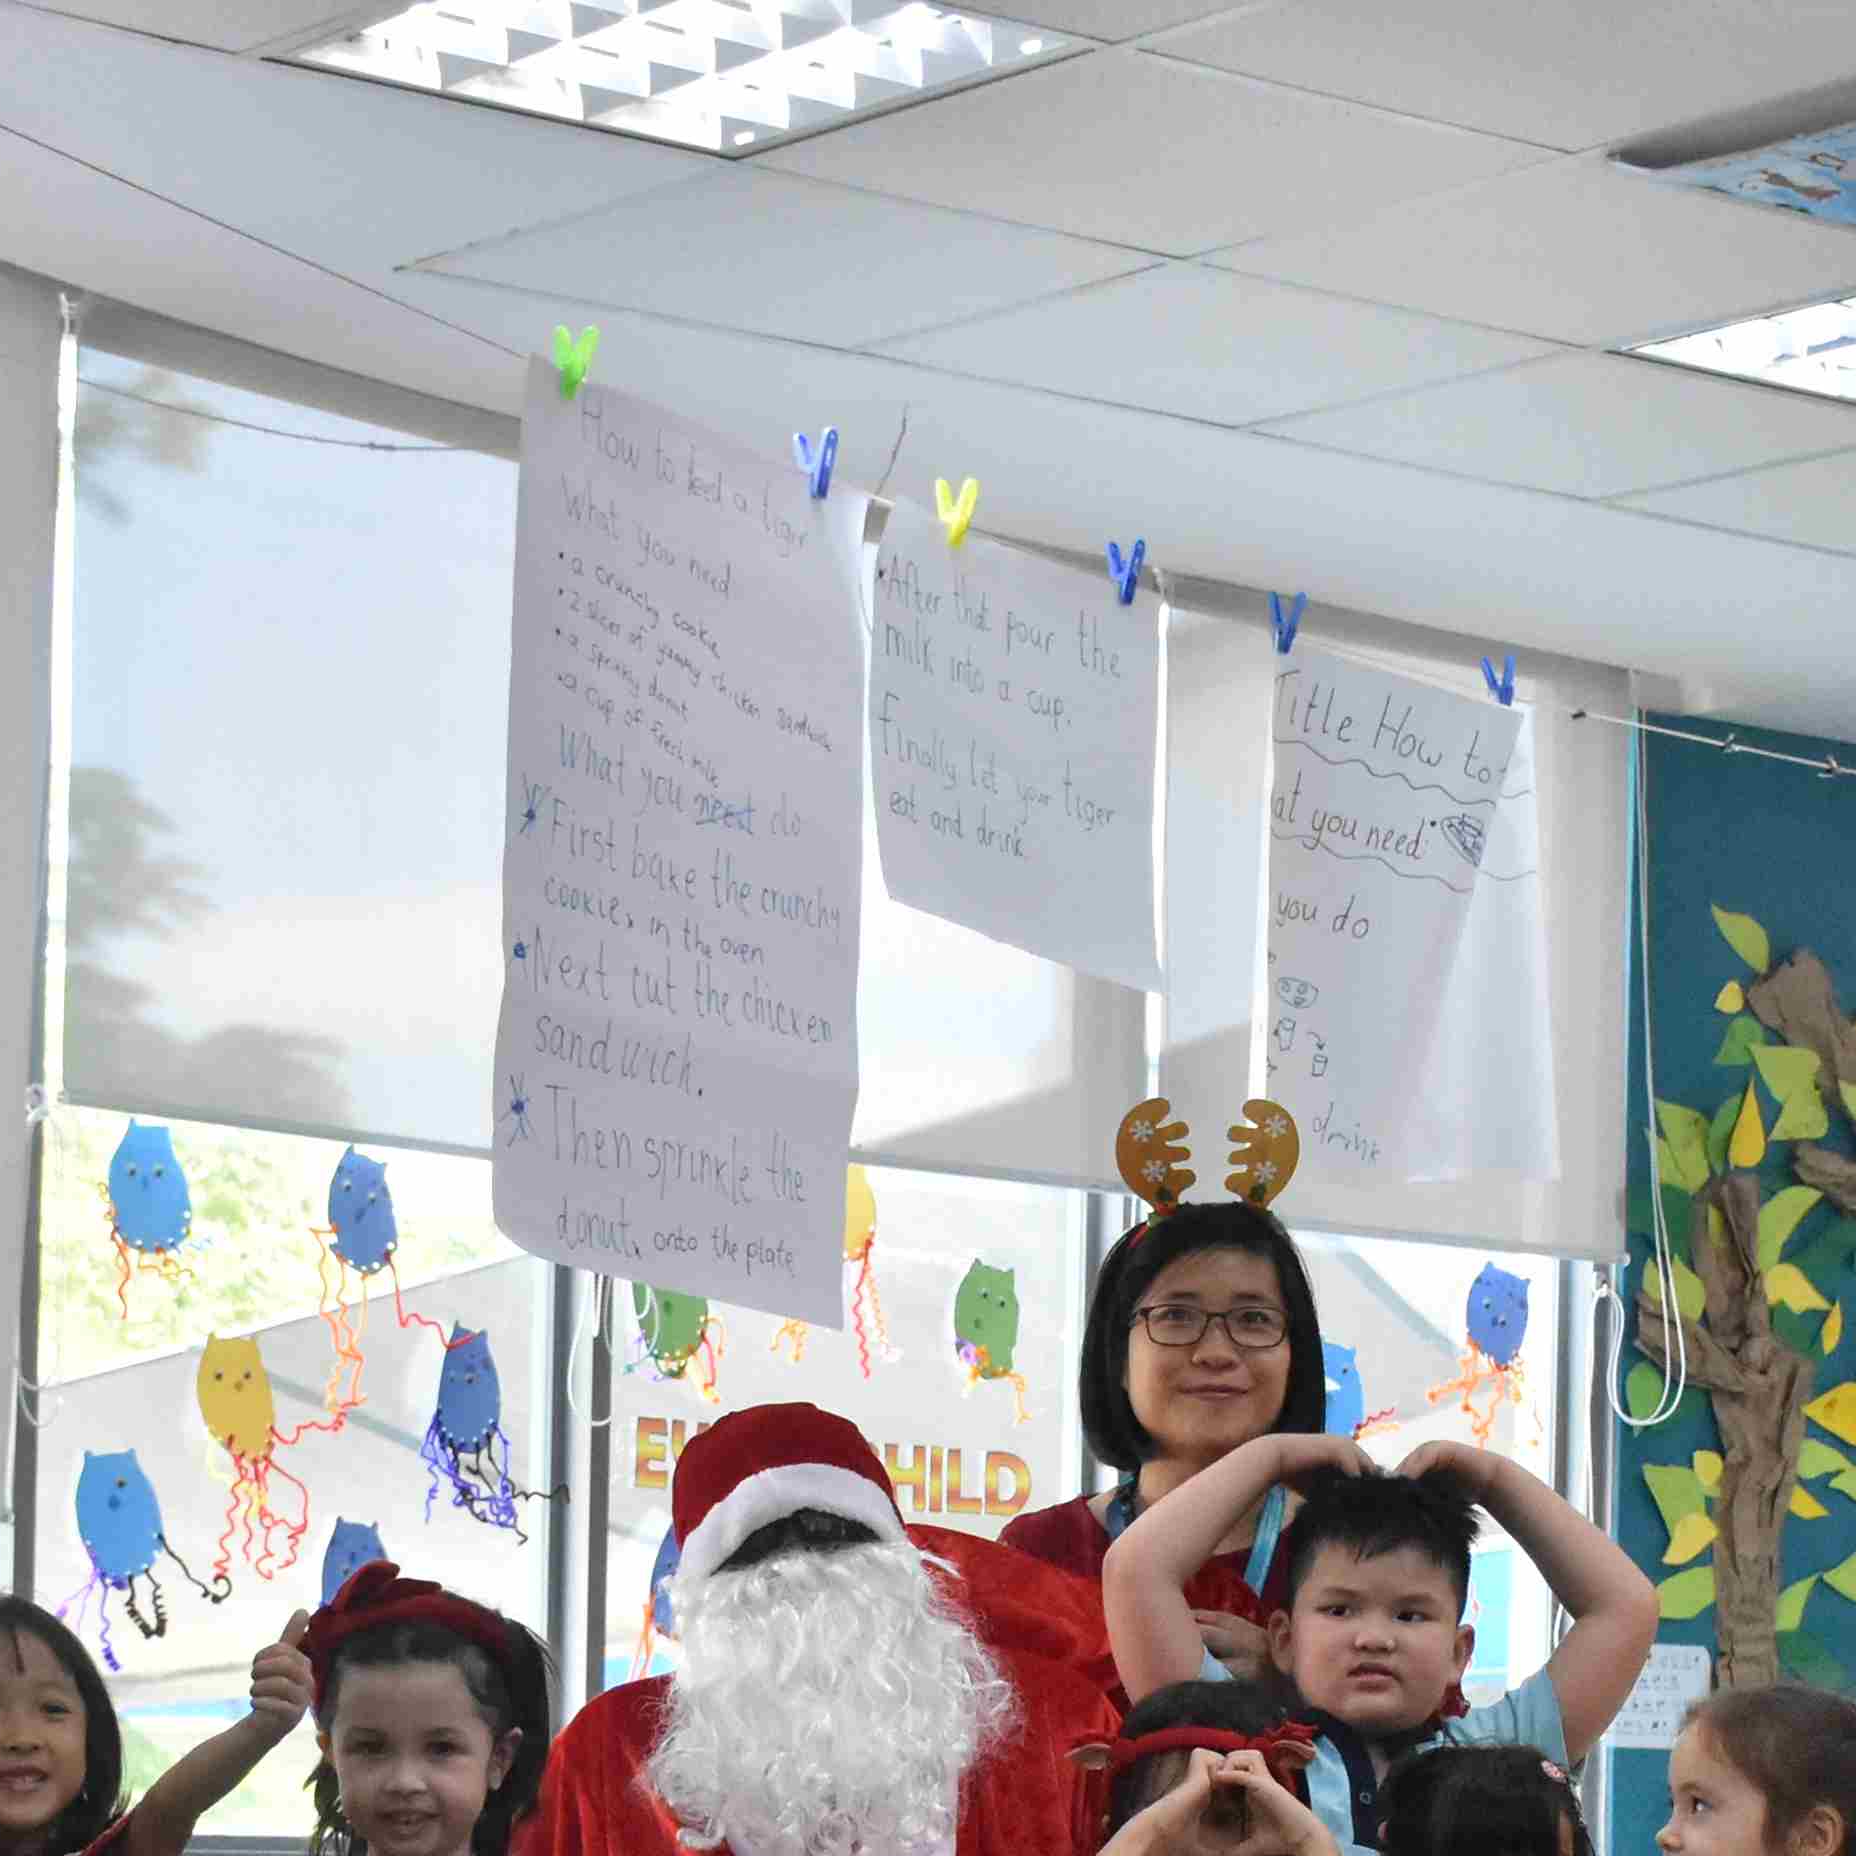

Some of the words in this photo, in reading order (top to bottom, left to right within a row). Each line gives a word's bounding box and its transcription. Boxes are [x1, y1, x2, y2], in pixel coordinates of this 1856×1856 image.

[581, 390, 640, 470] How
[561, 471, 621, 541] What
[634, 520, 676, 568] you
[885, 622, 935, 675] milk
[998, 679, 1013, 704] a
[887, 555, 942, 617] After
[1005, 610, 1057, 655] pour
[1078, 608, 1122, 680] the
[559, 721, 626, 799] What
[639, 765, 685, 818] you
[1274, 669, 1354, 746] Title
[1373, 693, 1443, 769] How
[1462, 729, 1493, 786] to
[1062, 759, 1118, 833] tiger
[1302, 805, 1357, 850] you
[551, 797, 618, 873] First
[631, 822, 698, 901] bake
[711, 847, 754, 912] the
[1276, 889, 1319, 931] you
[1331, 894, 1371, 939] do
[532, 925, 610, 1003] Next
[631, 960, 678, 1016] cut
[693, 961, 734, 1028] the
[544, 1083, 634, 1174] Then
[643, 1133, 754, 1208] sprinkle
[766, 1128, 809, 1203] the
[870, 1442, 1033, 1516] HILD
